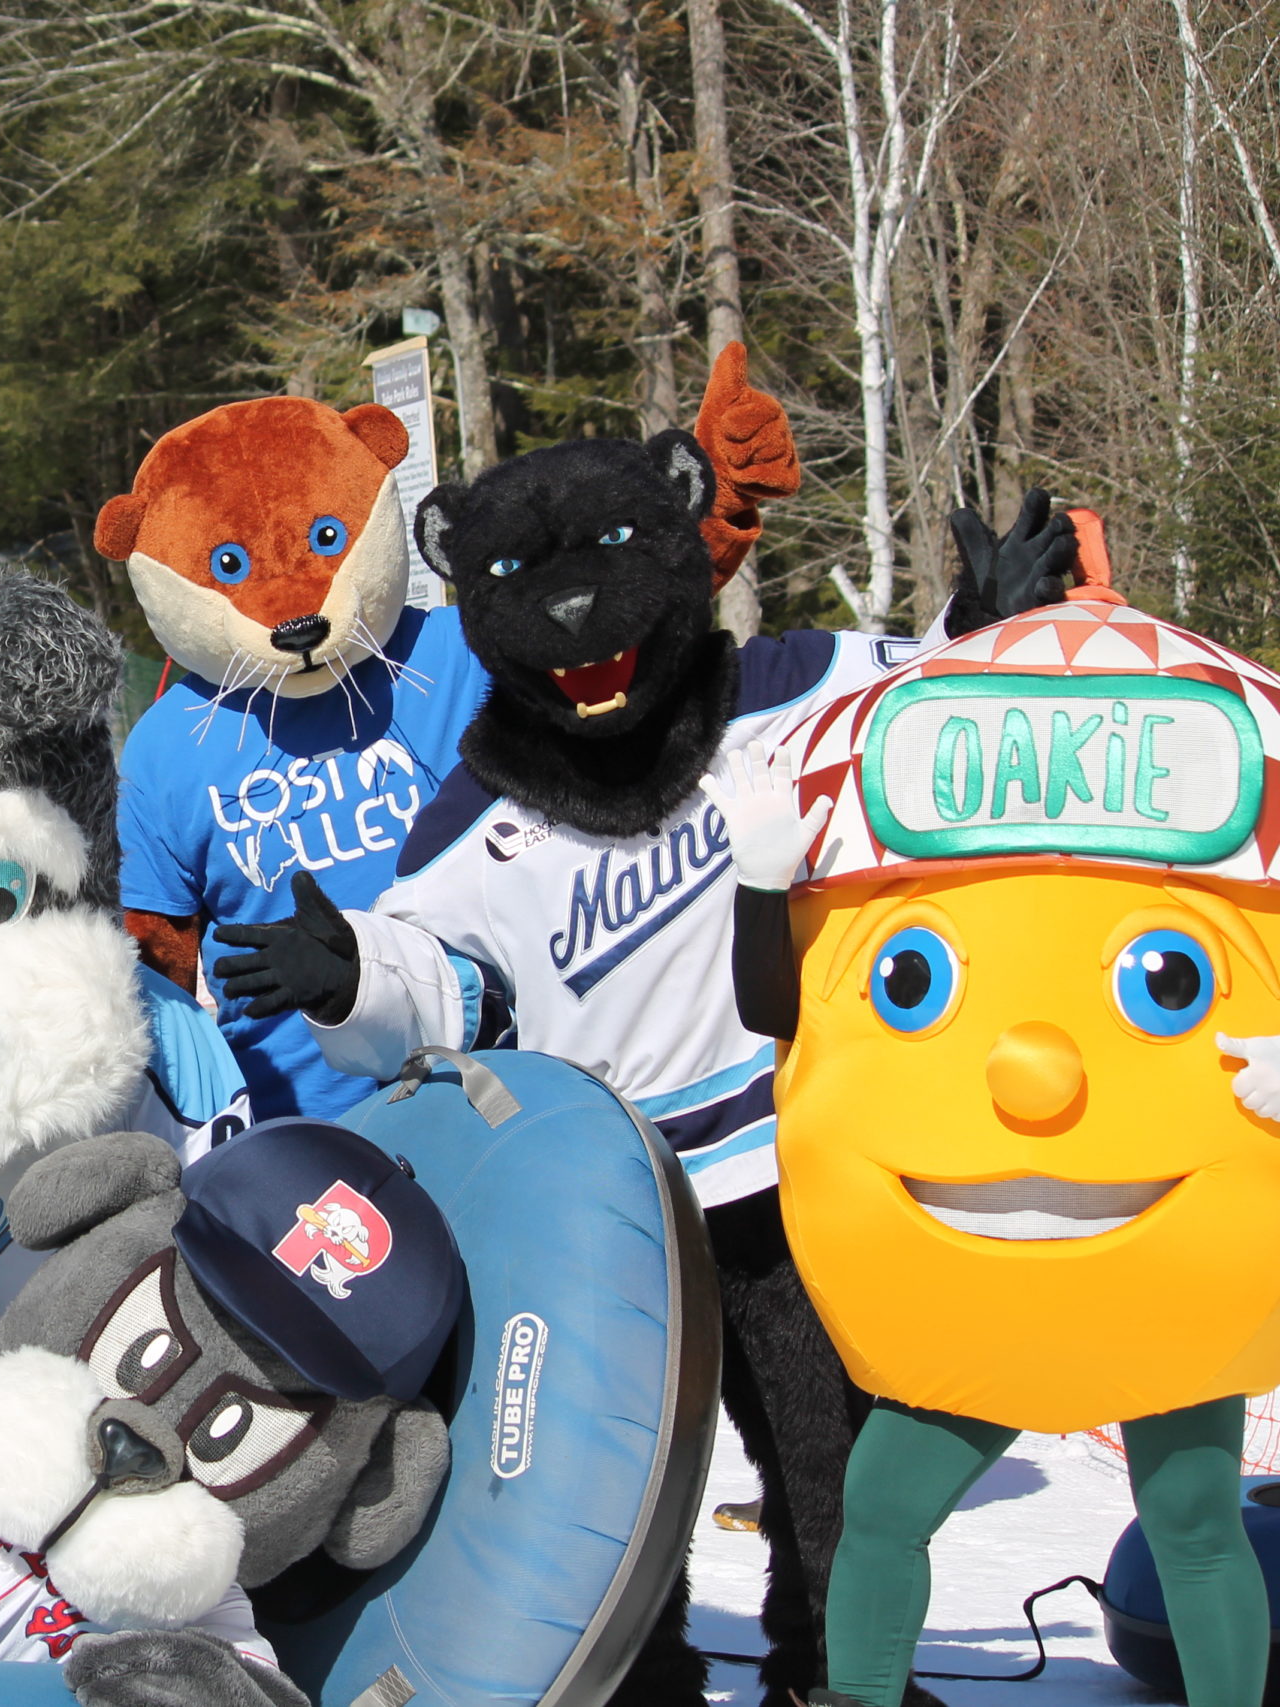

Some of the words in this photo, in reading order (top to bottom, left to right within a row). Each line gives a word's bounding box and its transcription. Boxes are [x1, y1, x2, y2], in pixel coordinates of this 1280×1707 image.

[208, 747, 344, 832] LOST
[525, 829, 552, 848] EAST
[549, 801, 731, 970] Maine
[496, 1320, 510, 1391] CANADA
[508, 1326, 534, 1380] PRO
[501, 1388, 523, 1464] TUBE
